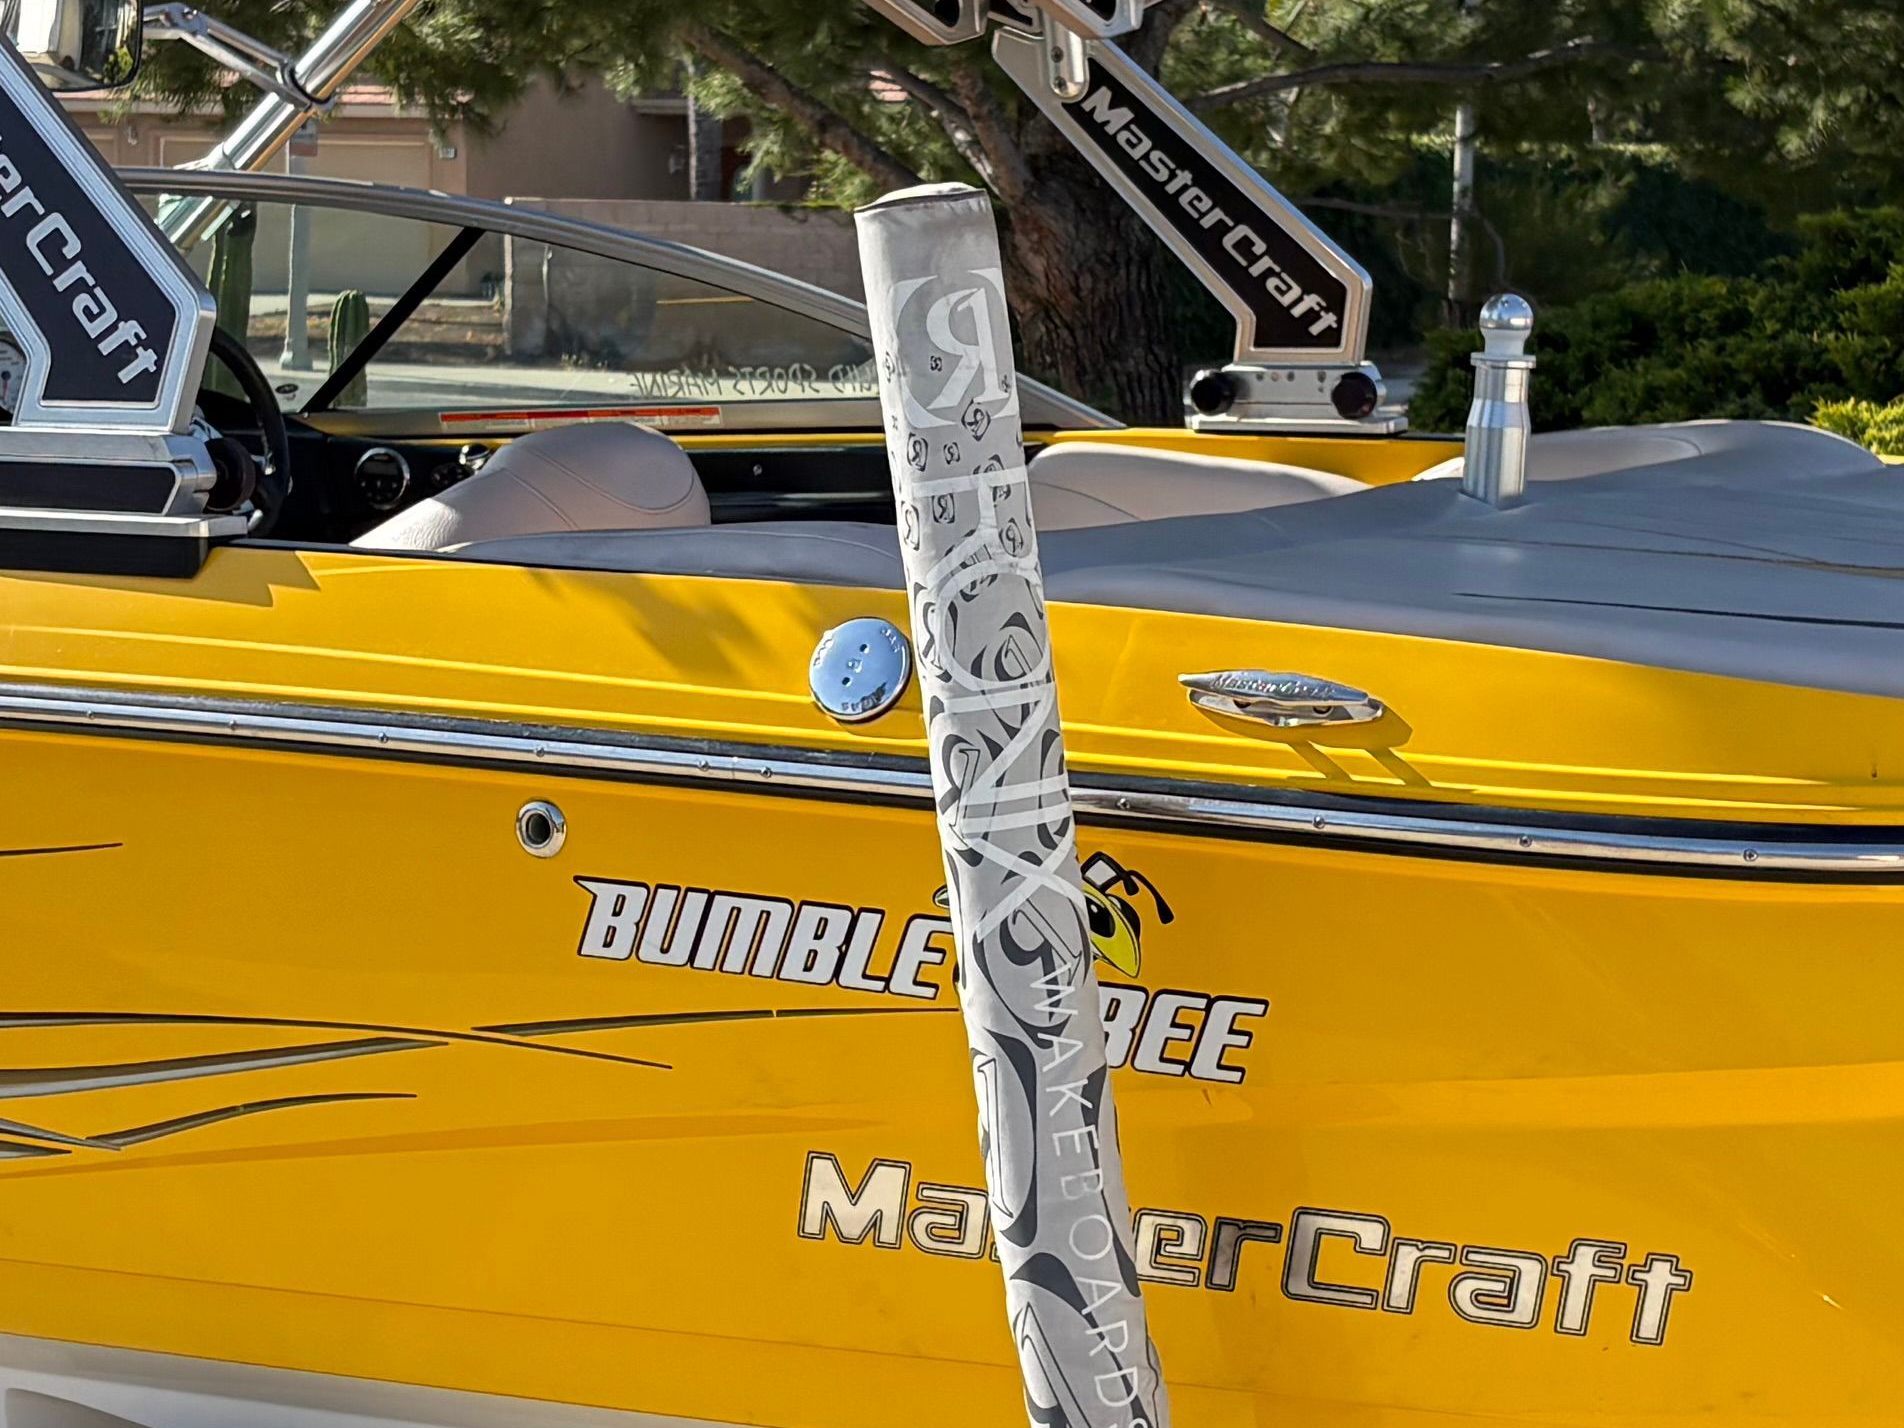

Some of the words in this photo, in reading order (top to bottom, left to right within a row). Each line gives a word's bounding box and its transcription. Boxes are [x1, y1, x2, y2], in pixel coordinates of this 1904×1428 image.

[1080, 84, 1338, 338] MasterCraft
[572, 874, 958, 1000] BUMBLE
[796, 1149, 1694, 1348] MaerCraft
